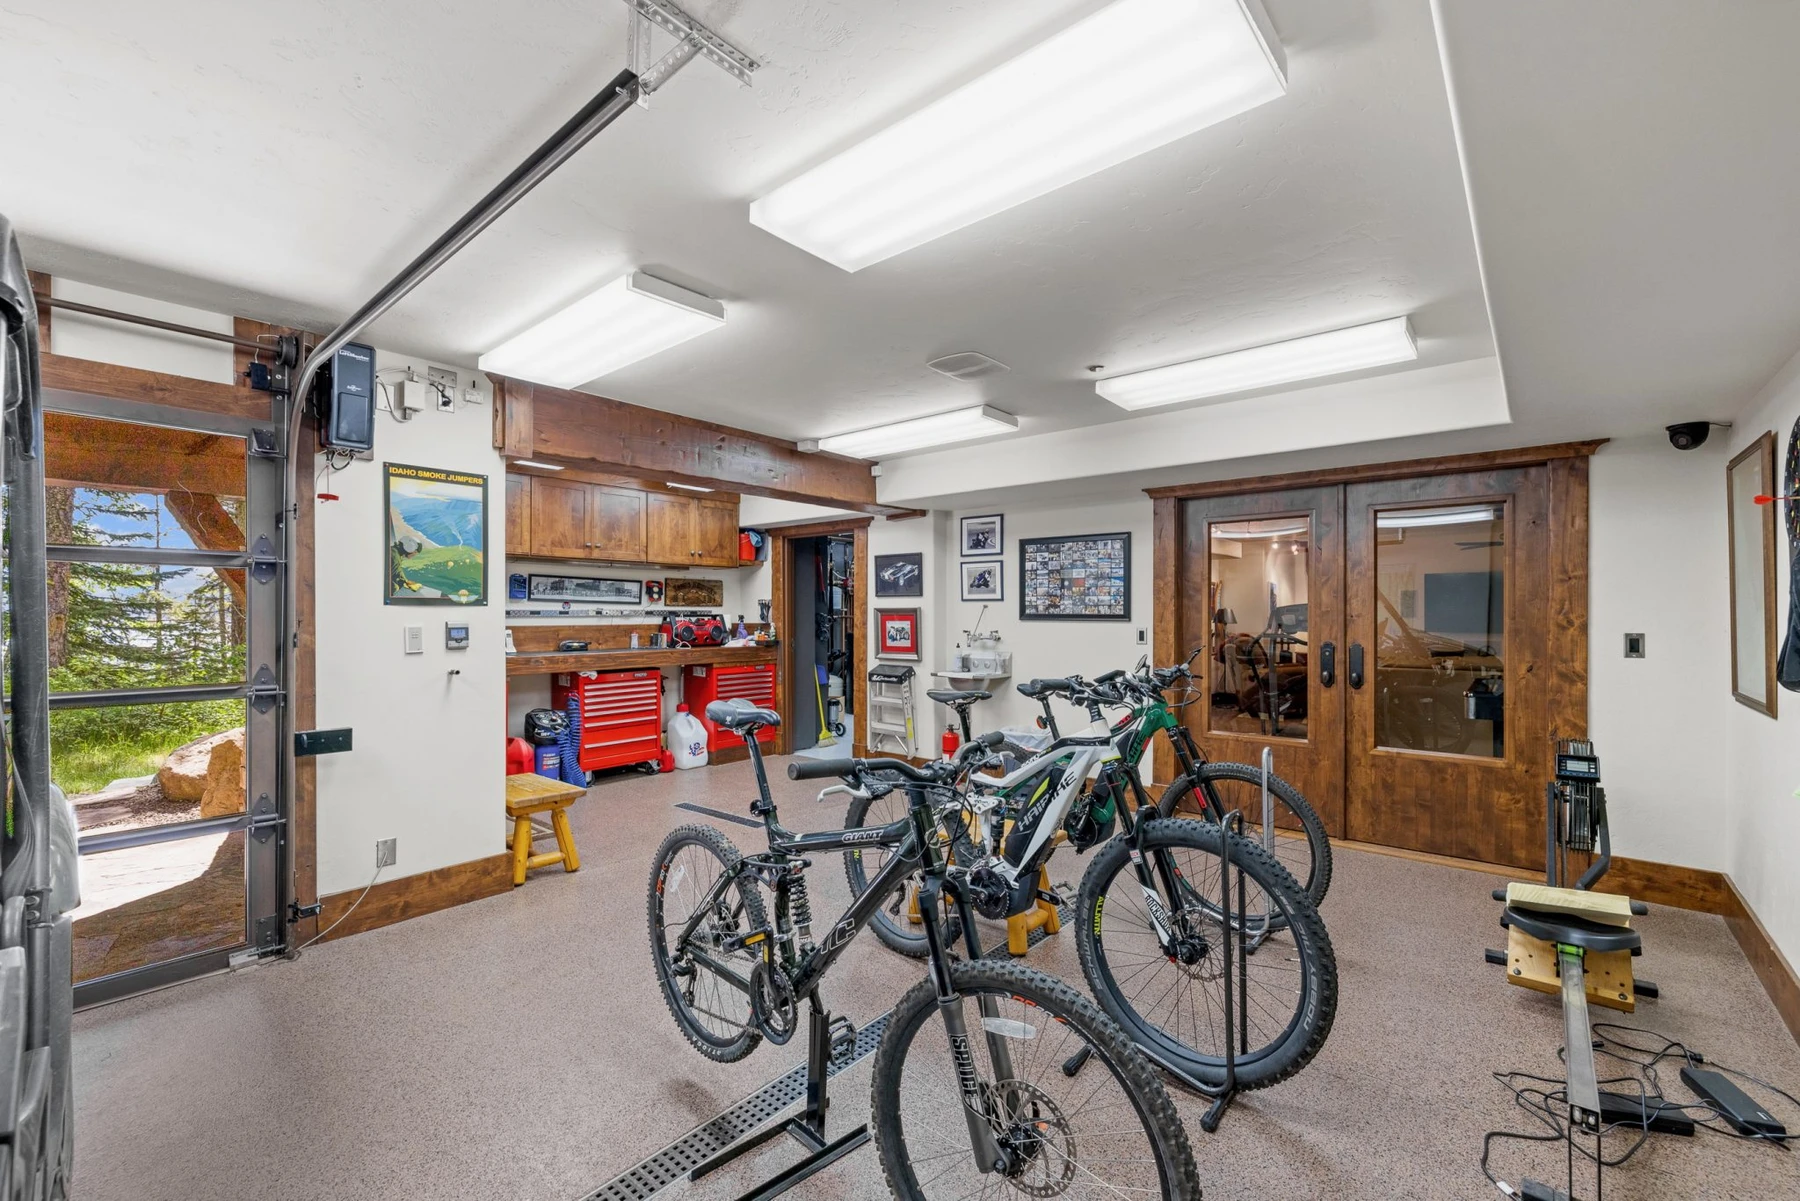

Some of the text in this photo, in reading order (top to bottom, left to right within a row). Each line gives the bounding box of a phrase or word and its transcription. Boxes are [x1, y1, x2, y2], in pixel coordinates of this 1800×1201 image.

[389, 466, 484, 485] IDAHO SMOKE JUMPERS
[841, 829, 885, 844] GIANT
[1082, 897, 1103, 990] SCHWALBE
[1303, 961, 1318, 1031] NOBBY
[950, 1036, 979, 1100] SPLICE
